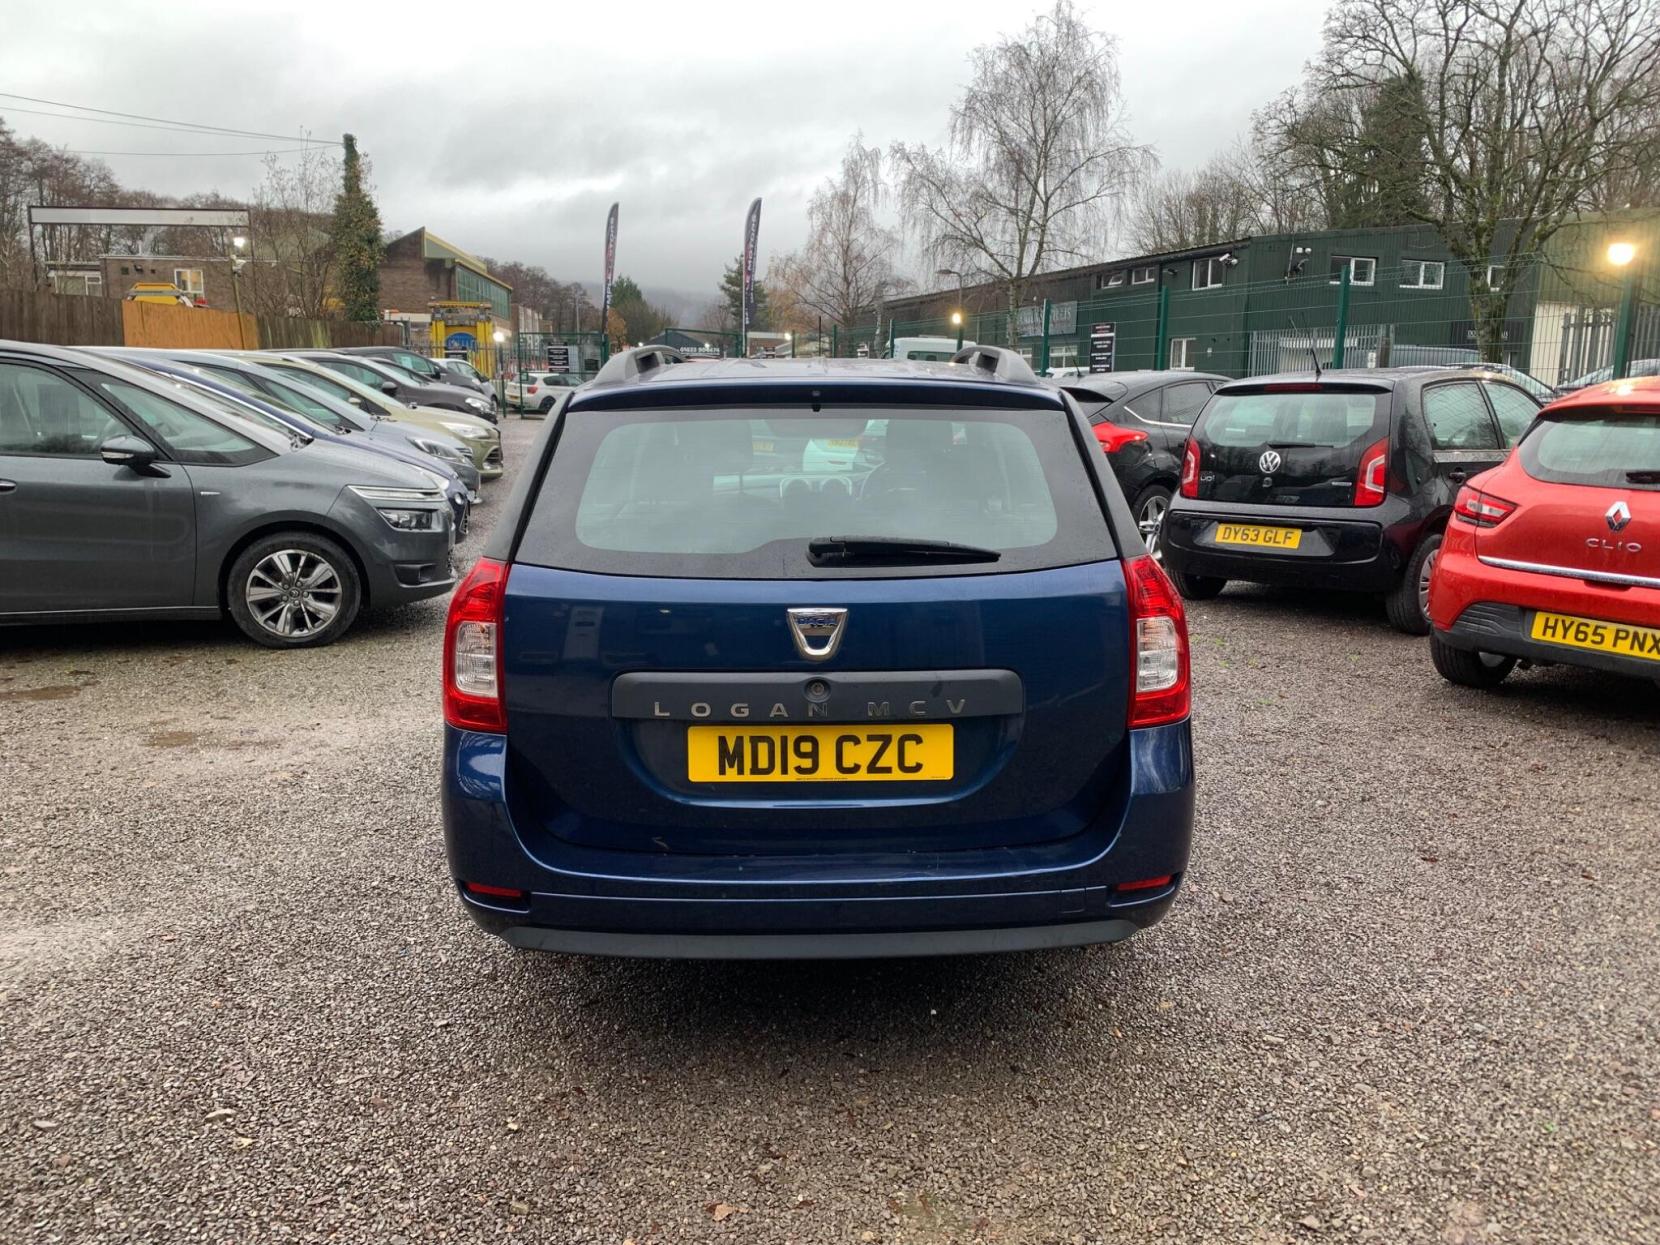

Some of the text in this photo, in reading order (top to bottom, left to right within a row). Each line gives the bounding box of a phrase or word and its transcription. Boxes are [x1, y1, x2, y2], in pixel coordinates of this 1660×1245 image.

[1222, 527, 1295, 545] DY63 GLF
[1585, 537, 1642, 553] CLIO
[1541, 616, 1660, 654] HY65 PNX
[653, 699, 966, 718] LOGAN MCV
[718, 733, 924, 776] MD19 CZC
